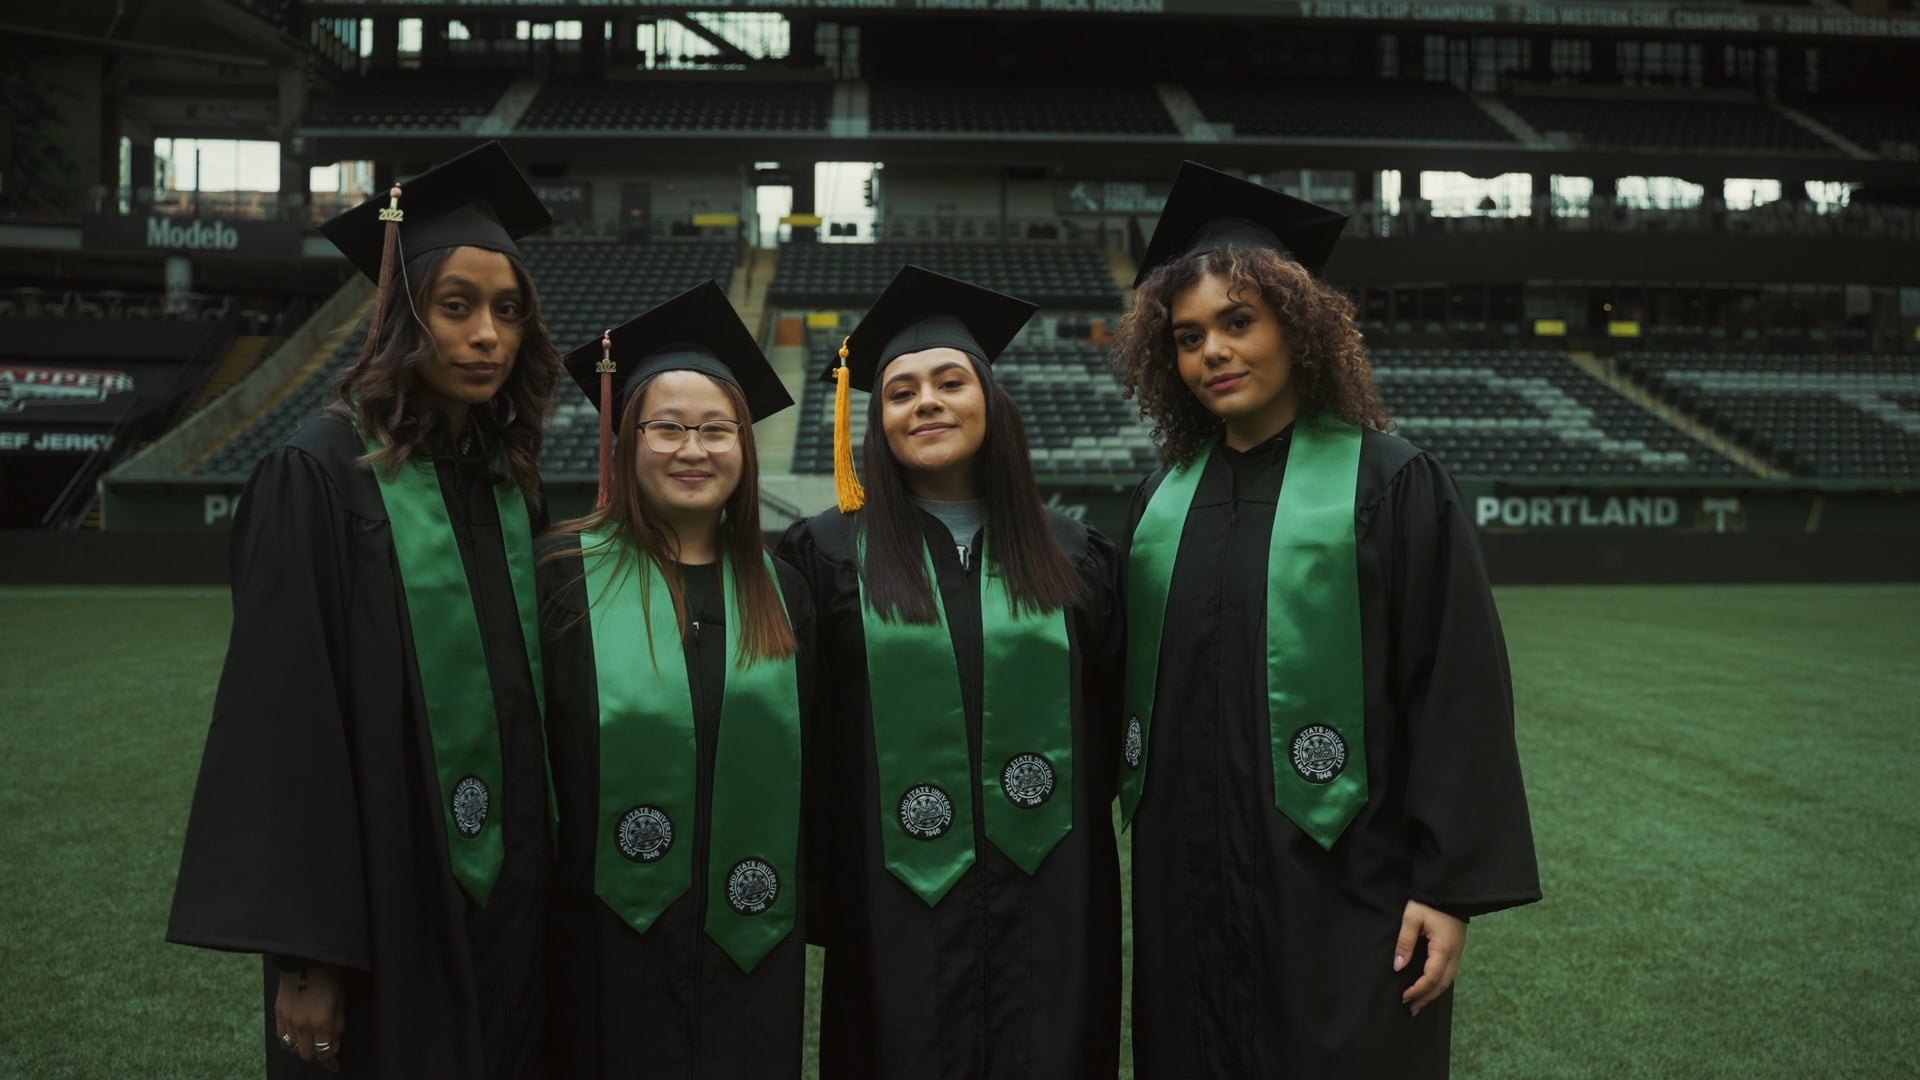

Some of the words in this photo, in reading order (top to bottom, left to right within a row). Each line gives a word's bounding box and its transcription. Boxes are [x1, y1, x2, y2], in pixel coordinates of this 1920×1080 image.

[378, 207, 404, 222] 2022
[146, 216, 240, 250] Modelo
[595, 359, 617, 373] 2022
[32, 431, 115, 452] JERKY
[1475, 496, 1680, 528] PORTLAND
[1300, 726, 1323, 741] STATE
[1324, 728, 1345, 769] UNIVERSITY
[1010, 755, 1032, 769] STATE
[1293, 738, 1311, 776] PORTLAND
[906, 786, 930, 801] STATE
[625, 807, 649, 823] STATE
[734, 861, 755, 876] STATE
